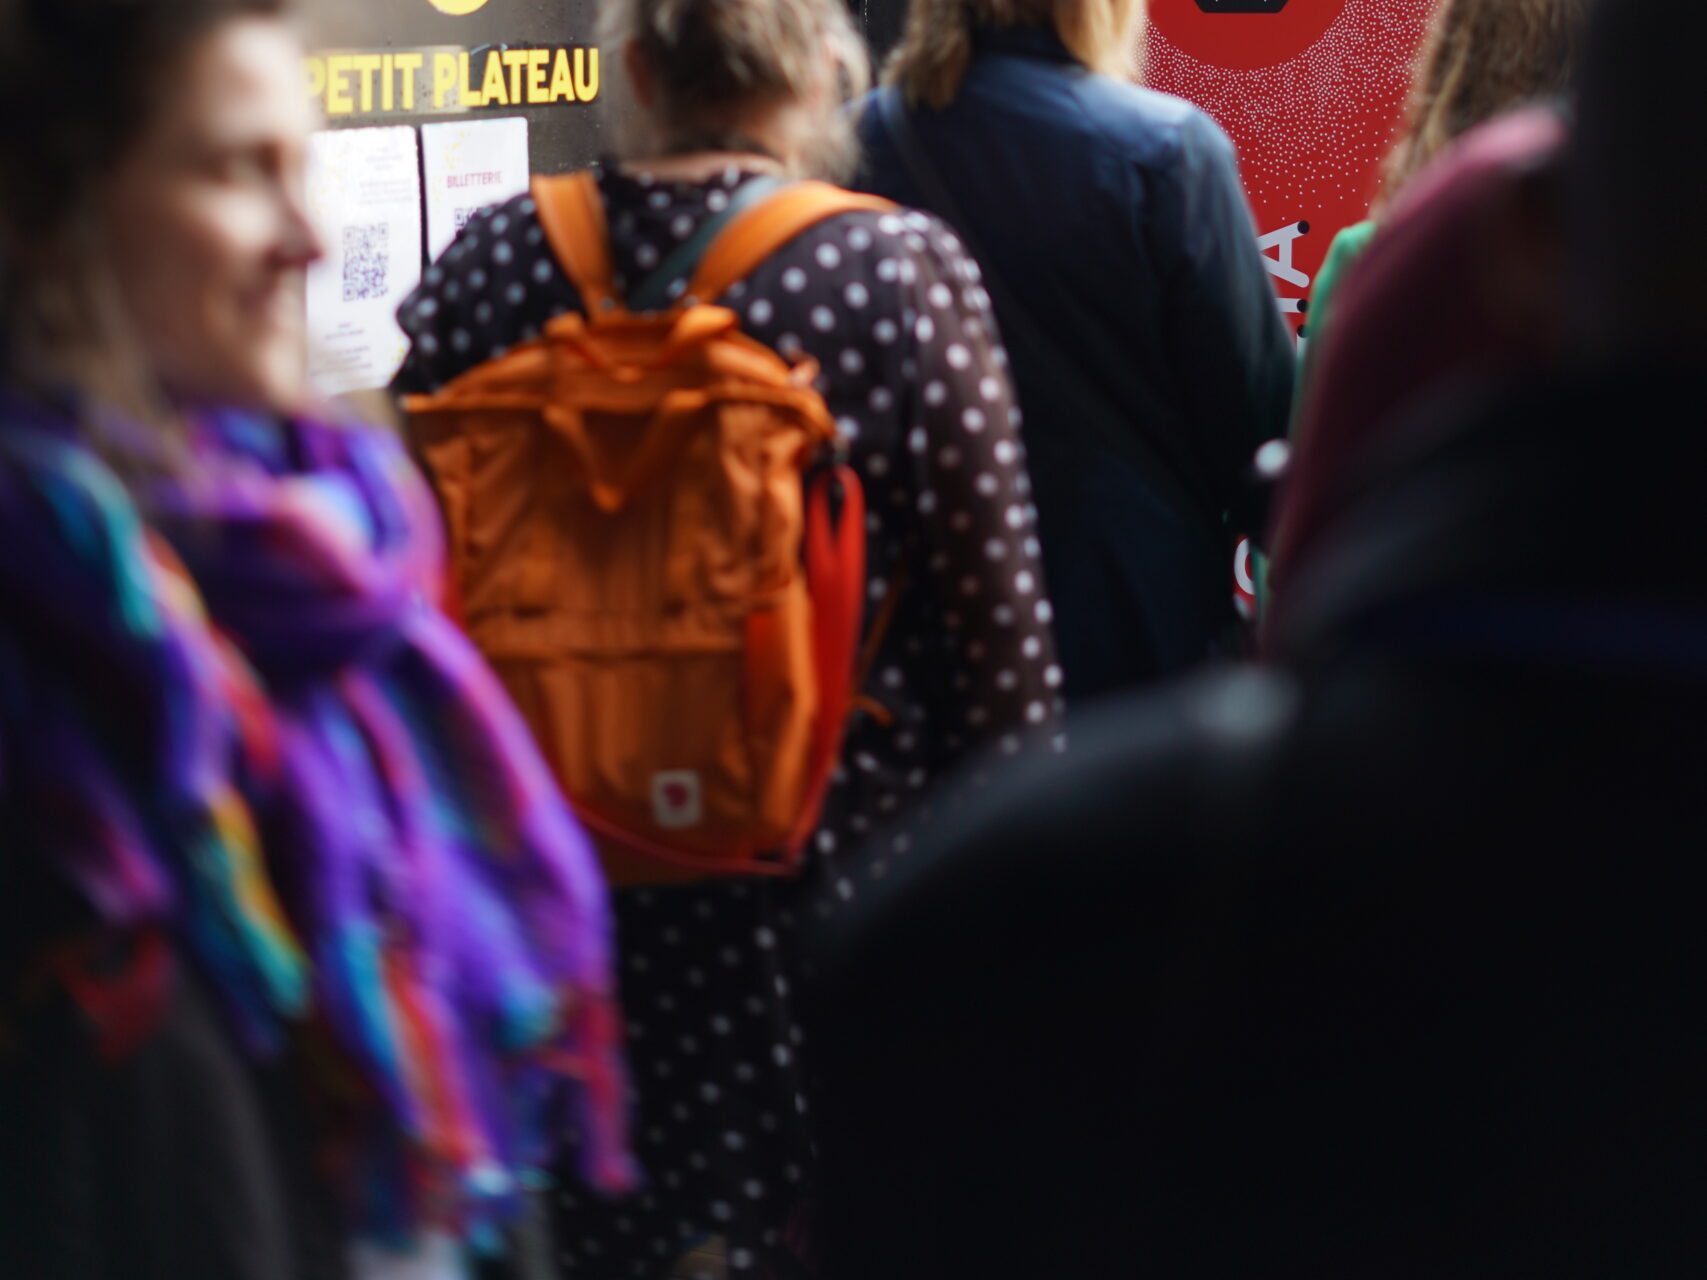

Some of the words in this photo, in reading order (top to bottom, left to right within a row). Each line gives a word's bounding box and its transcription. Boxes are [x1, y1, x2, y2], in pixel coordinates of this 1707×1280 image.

[304, 52, 423, 114] PETIT
[433, 47, 599, 108] PLATEAU
[446, 170, 504, 189] BILLETTERIE
